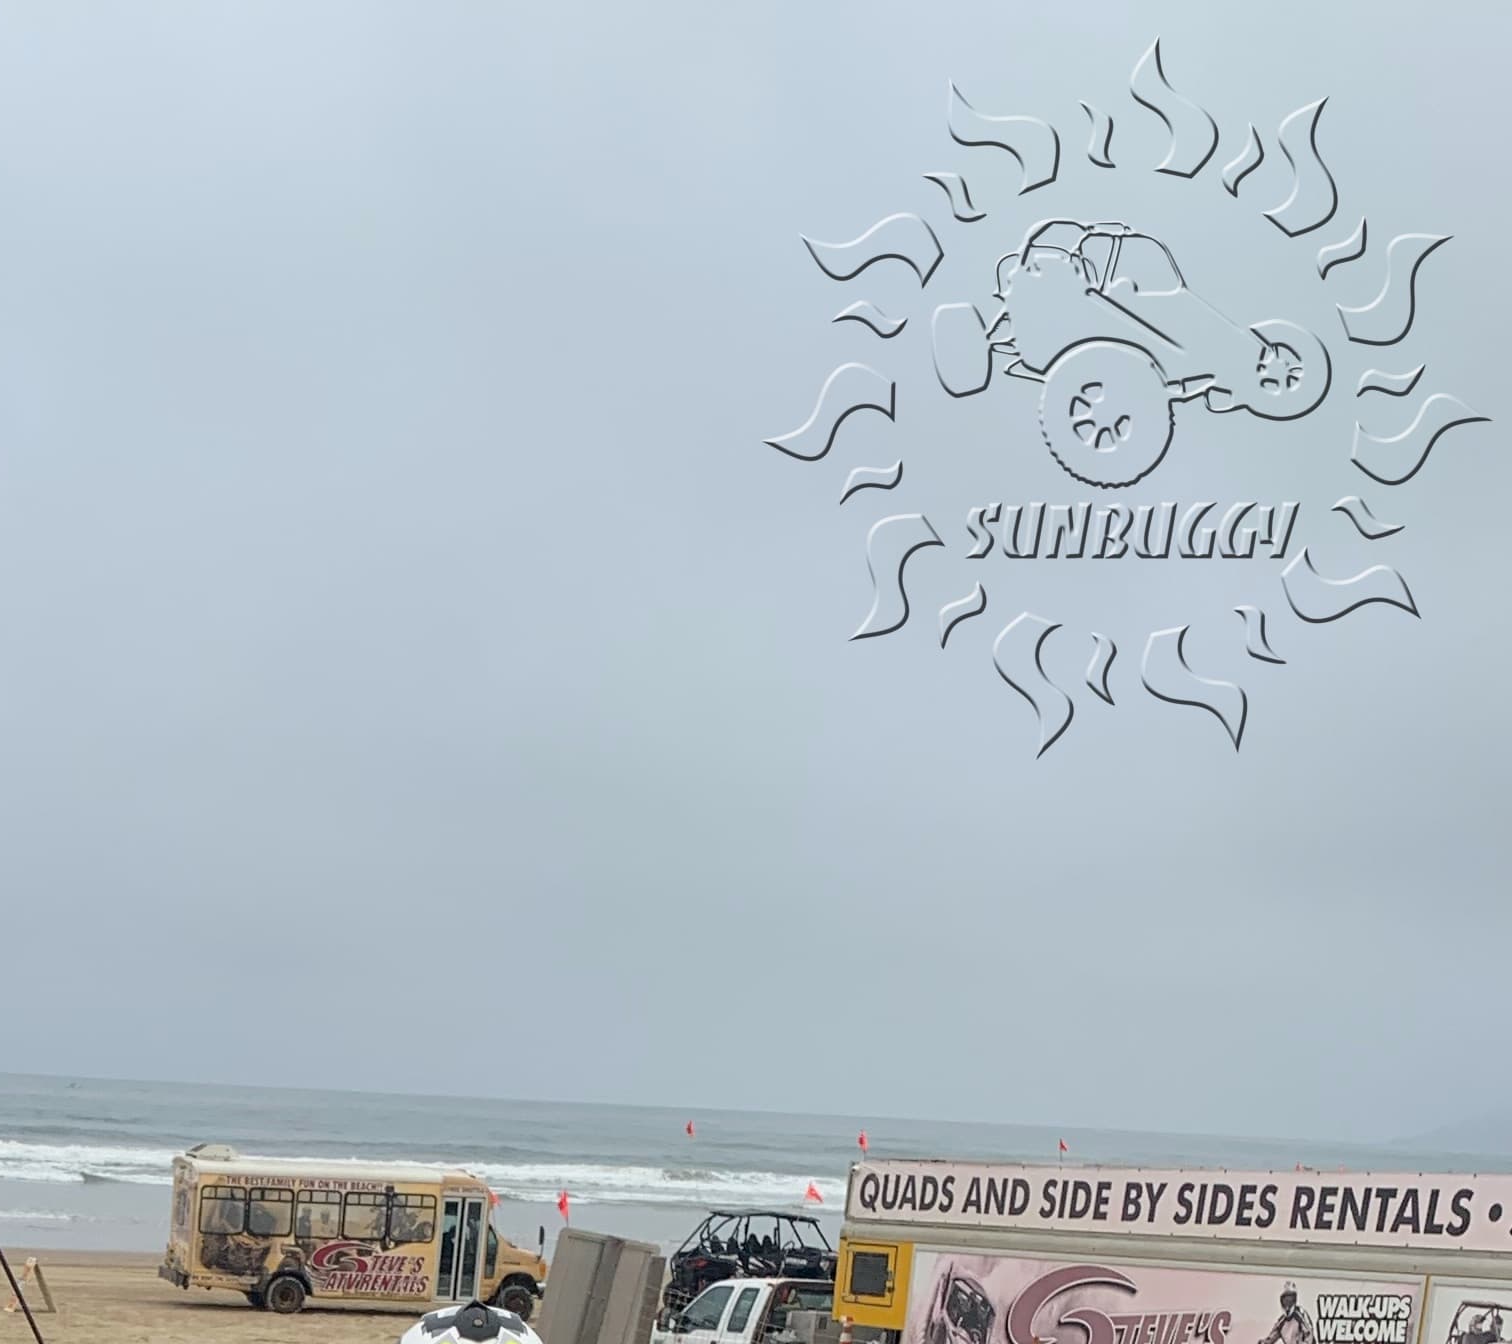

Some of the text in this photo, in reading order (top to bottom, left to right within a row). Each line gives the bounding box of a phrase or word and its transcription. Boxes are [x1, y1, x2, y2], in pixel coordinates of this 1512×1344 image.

[226, 1176, 241, 1185] THE
[299, 1178, 316, 1188] FUN
[318, 1179, 330, 1189] ON
[333, 1180, 348, 1190] THE
[860, 1173, 1475, 1237] QUADS AND SIDE BY SIDES RENTALS
[1317, 1294, 1412, 1320] WALK-UPS
[1317, 1318, 1408, 1344] WELCOME
